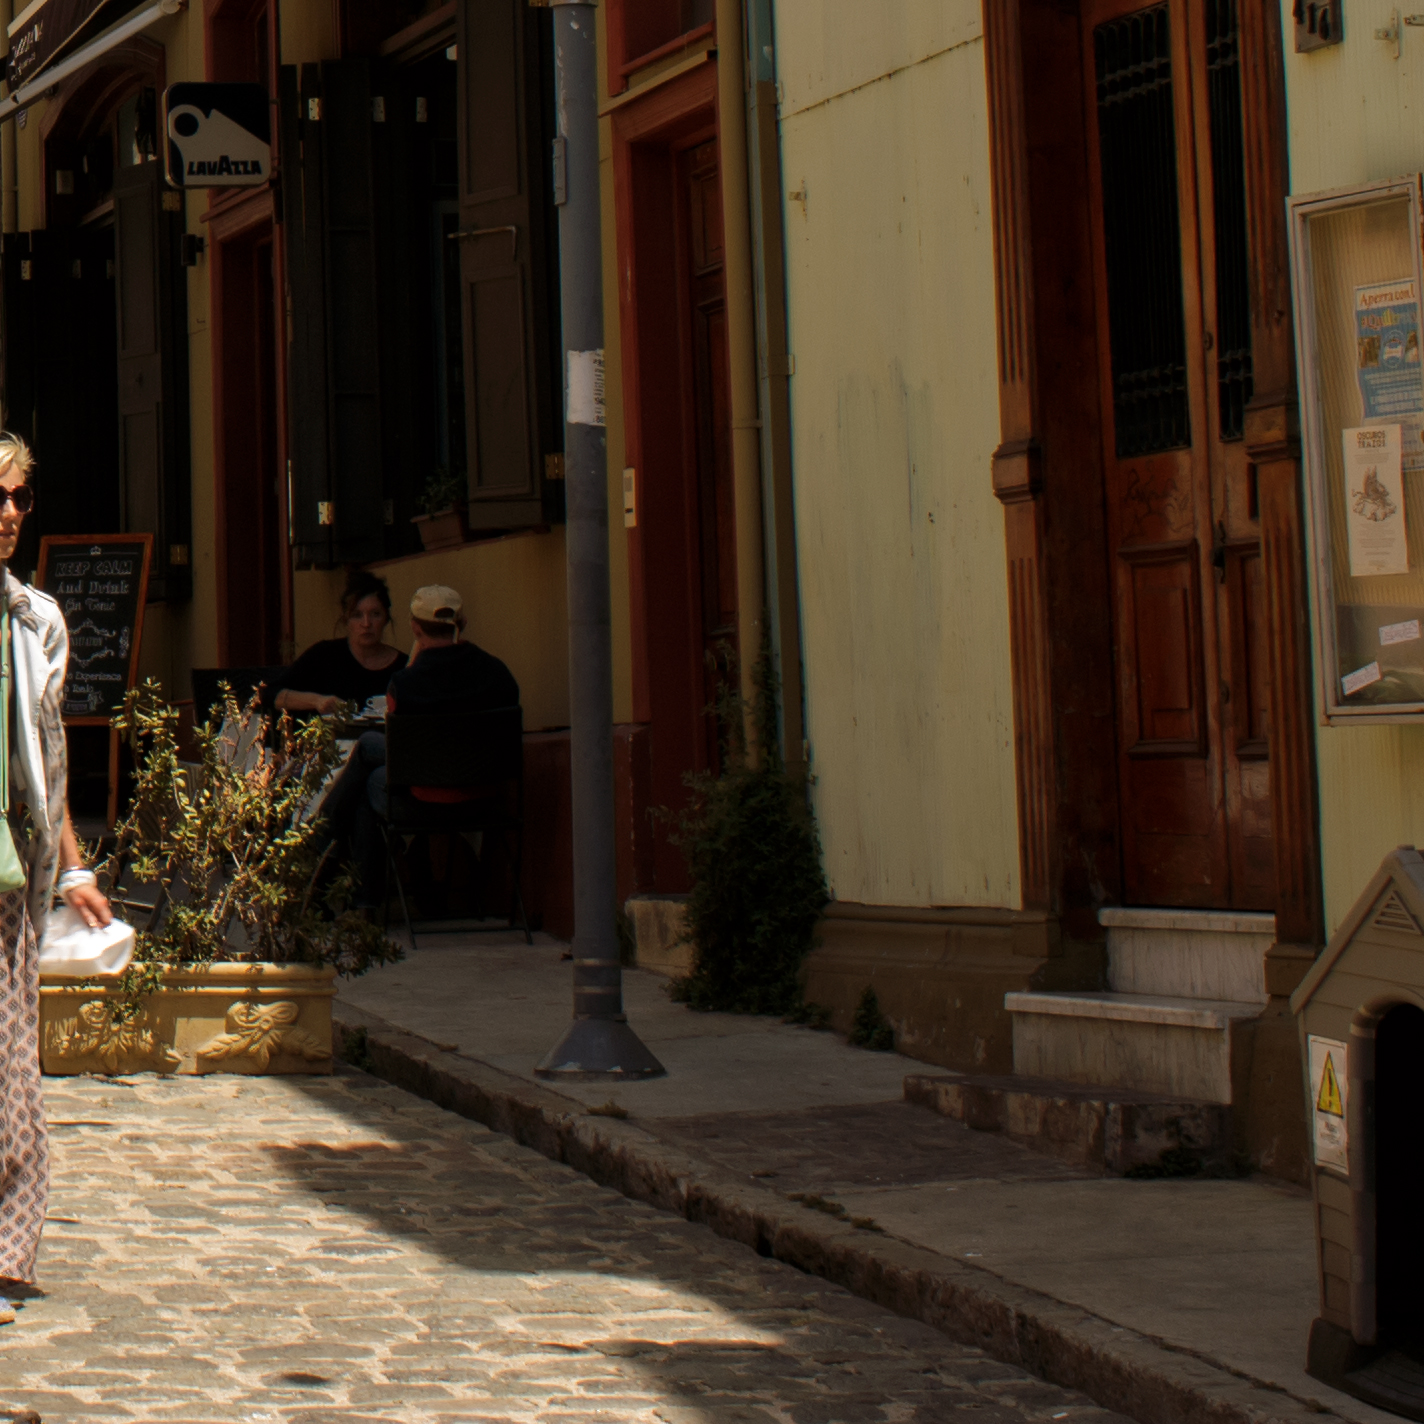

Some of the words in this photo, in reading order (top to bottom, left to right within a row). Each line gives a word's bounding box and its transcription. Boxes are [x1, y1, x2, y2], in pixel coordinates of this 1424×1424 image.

[187, 155, 262, 176] LAVAZZA
[55, 561, 91, 577] KEEP
[93, 560, 133, 576] CALM
[56, 580, 83, 594] And
[89, 580, 130, 594] Drink
